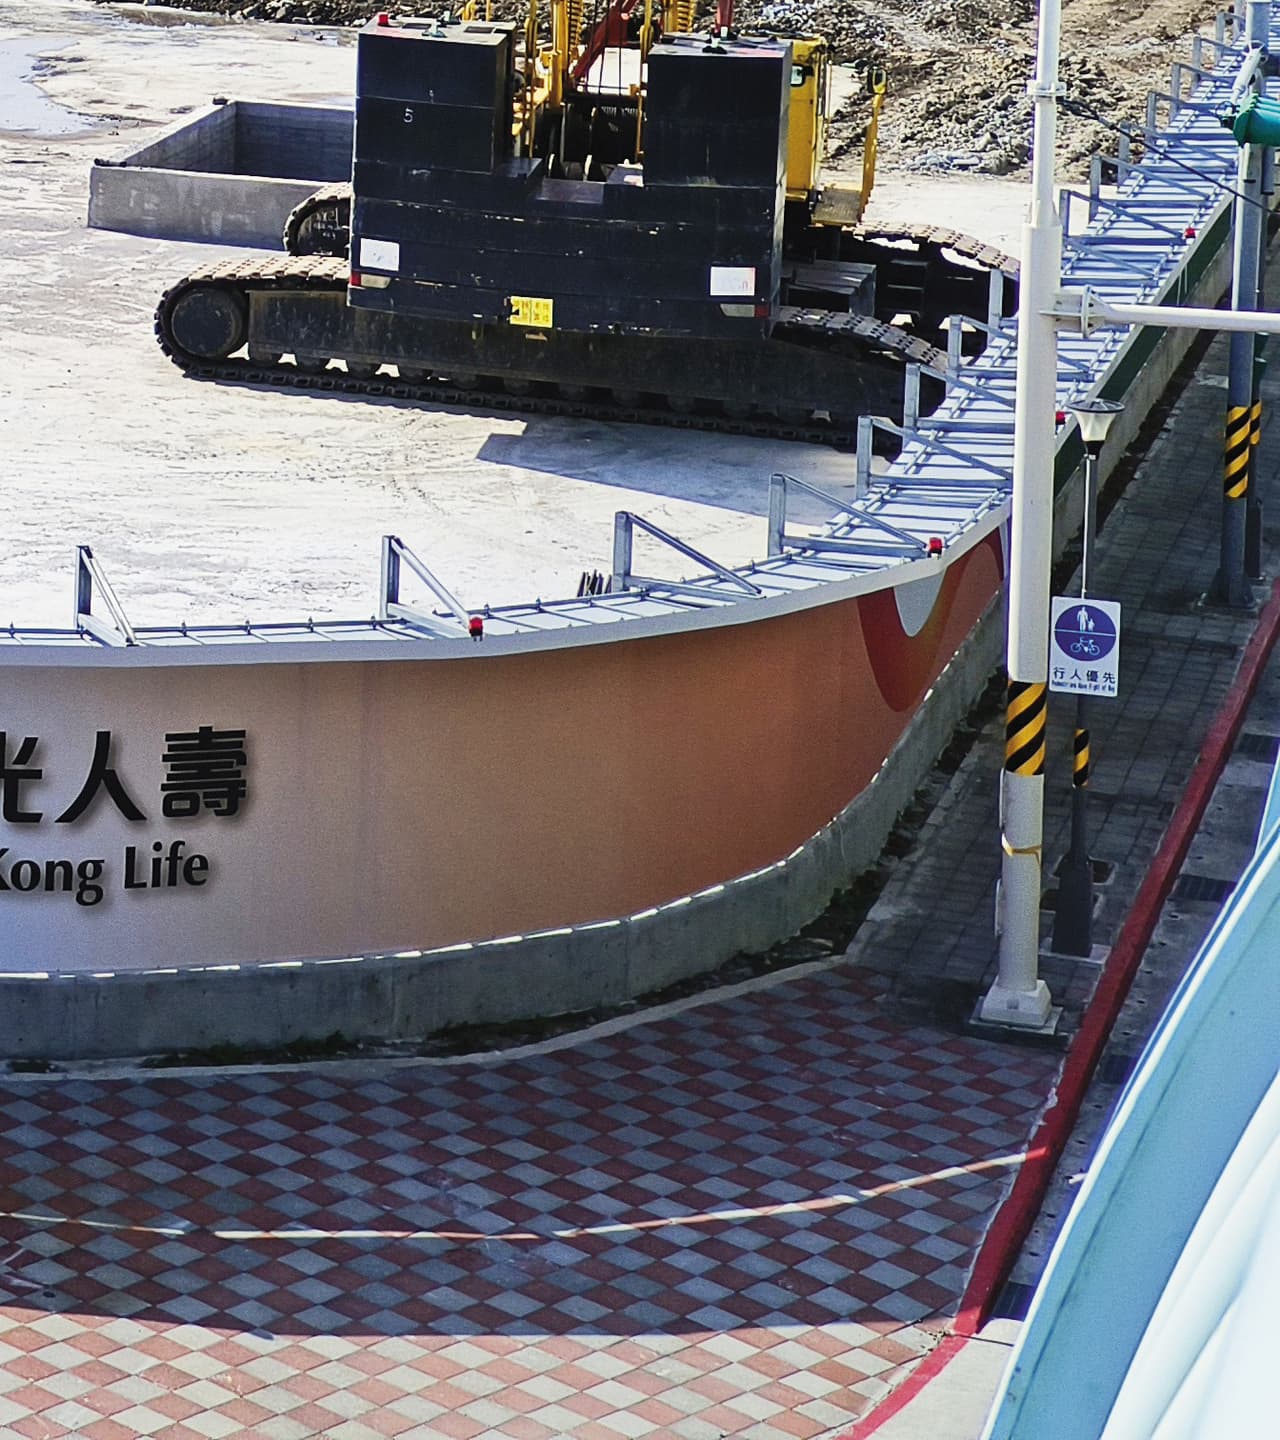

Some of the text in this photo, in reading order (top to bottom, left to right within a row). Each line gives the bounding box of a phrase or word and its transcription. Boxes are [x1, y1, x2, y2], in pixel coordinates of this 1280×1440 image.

[1052, 666, 1116, 685] 行人優先
[124, 841, 211, 890] Life
